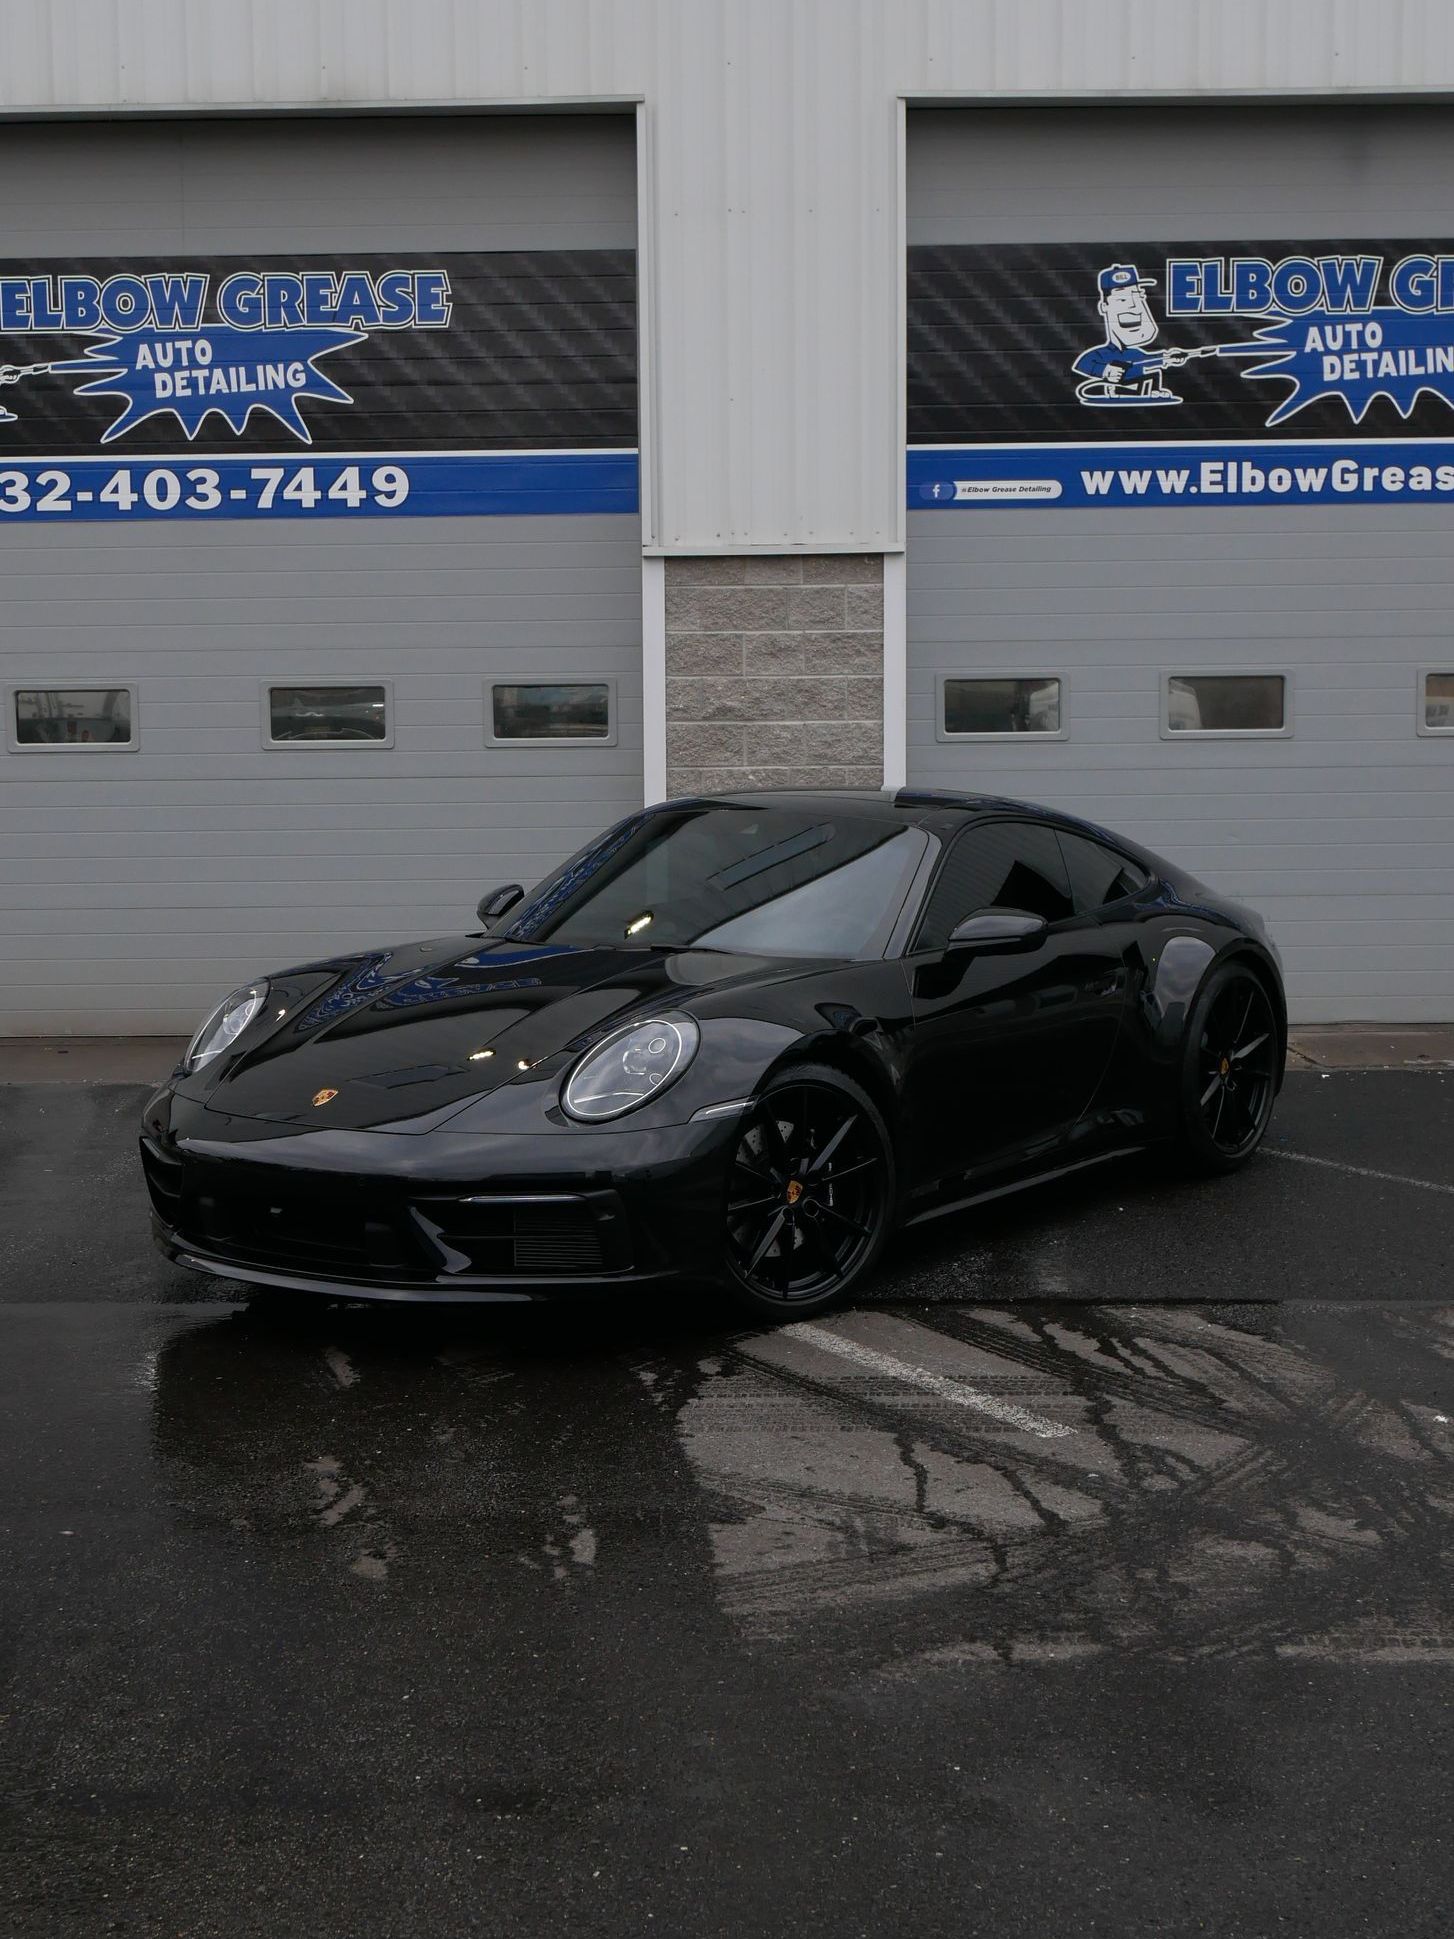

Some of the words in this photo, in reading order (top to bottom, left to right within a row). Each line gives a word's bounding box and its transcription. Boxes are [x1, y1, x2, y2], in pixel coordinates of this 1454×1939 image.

[0, 273, 210, 333] ELBOW
[218, 271, 452, 331] GREASE
[1166, 255, 1384, 317] ELBOW
[136, 339, 213, 370] AUTO
[1304, 321, 1383, 353] AUTO
[155, 362, 306, 398] DETAILING
[1322, 346, 1454, 382] DETAILIN
[0, 467, 409, 512] 32-403-7449
[1018, 484, 1052, 493] Detailing
[1080, 459, 1454, 495] www.ElbowGreas
